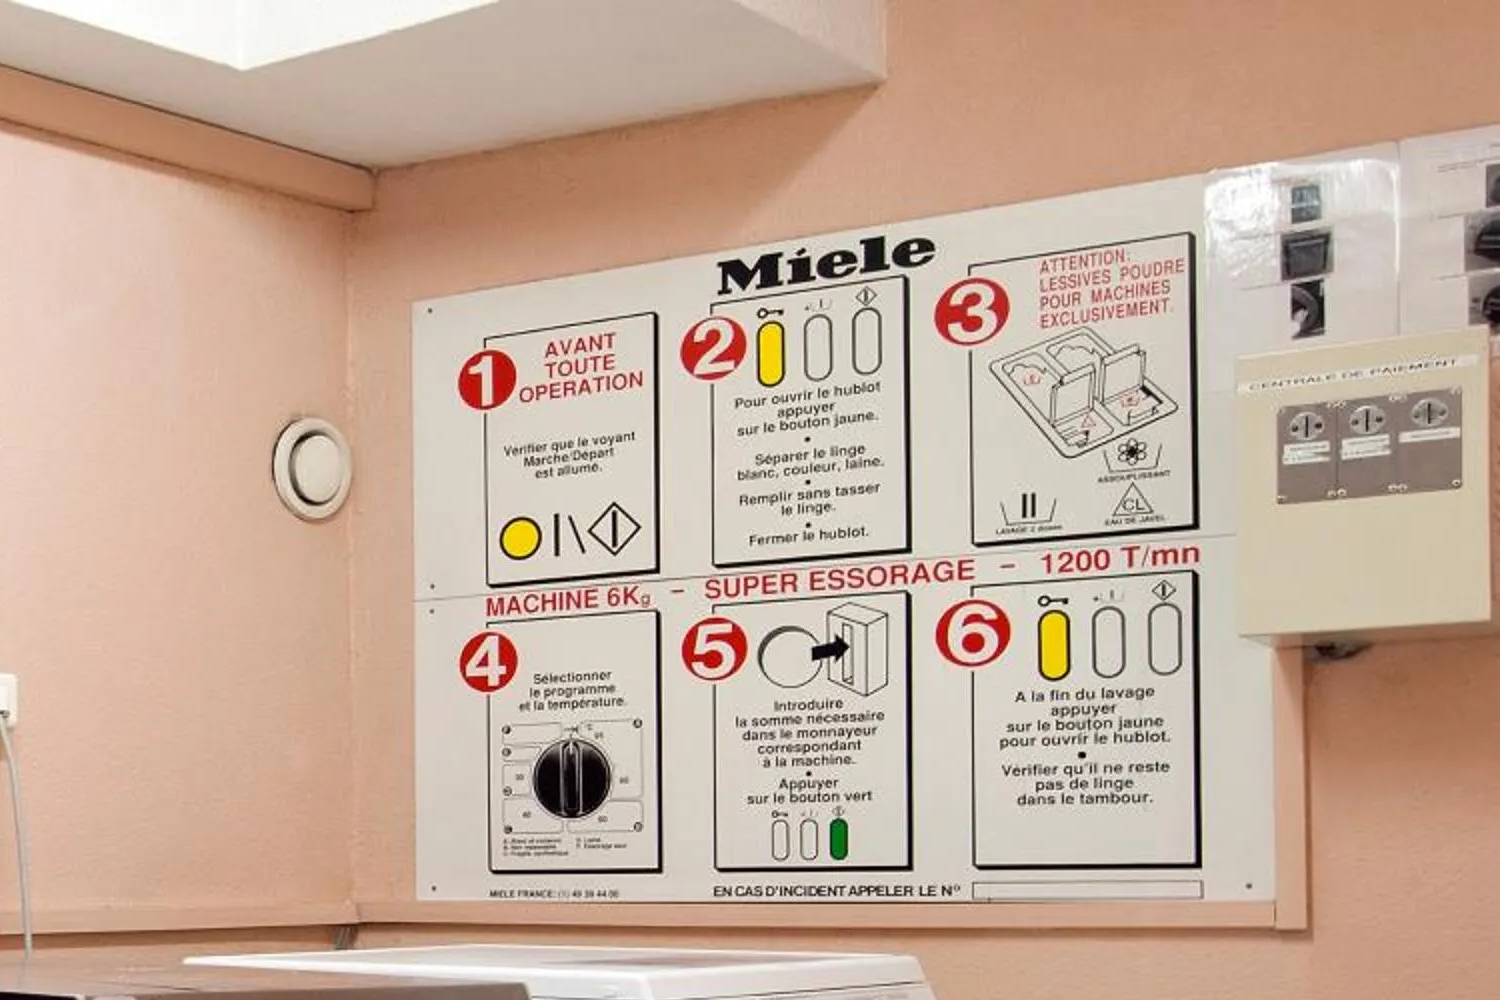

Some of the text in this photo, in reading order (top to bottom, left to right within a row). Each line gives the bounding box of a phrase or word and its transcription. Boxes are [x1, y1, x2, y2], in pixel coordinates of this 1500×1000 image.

[717, 236, 936, 295] Miele
[1040, 258, 1185, 293] LESSIVES POUDRE
[1040, 279, 1172, 311] POUR MACHINES
[948, 282, 997, 343] 3
[545, 332, 616, 358] AVANT
[693, 319, 737, 375] 2
[545, 354, 616, 378] TOUTE
[1249, 359, 1457, 391] CENTRALE DE PAIEMENT
[468, 355, 494, 407] 1
[519, 371, 644, 403] OPERATION
[735, 381, 881, 410] Pour ouvrir le hublot
[777, 402, 836, 419] appuyer
[737, 411, 879, 437] sur le bouton jaune.
[551, 440, 575, 454] que
[578, 437, 589, 448] le
[592, 432, 636, 448] voyant
[755, 444, 866, 467] Séparer le linge
[535, 467, 554, 479] est
[737, 456, 885, 481] blanc, couleur, laine.
[739, 483, 881, 507] Remplir sans tasser
[781, 501, 836, 516] le linge.
[1104, 518, 1123, 527] EAU
[749, 526, 869, 546] Fermer le hublot.
[486, 588, 599, 617] MACHINE
[705, 573, 798, 599] SUPER
[809, 559, 975, 592] ESSORAGE
[1041, 550, 1110, 575] 1200
[1120, 545, 1200, 569] T/mn
[948, 602, 999, 664] 6
[466, 636, 507, 686] 4
[693, 624, 736, 679] 5
[529, 684, 617, 699] le programme
[1014, 687, 1155, 702] A la fin du lavage
[519, 701, 531, 712] et
[533, 701, 545, 711] la
[774, 699, 844, 712] Introduire
[1051, 703, 1117, 718] appuyer
[735, 709, 885, 728] la somme nécessaire
[1006, 716, 1164, 733] sur le bouton jaune
[742, 725, 877, 741] dans le monnayeur
[999, 730, 1171, 750] pour ouvrir le hublot.
[757, 739, 861, 755] correspondant
[775, 756, 787, 767] la
[1063, 762, 1098, 778] qu'il
[1103, 763, 1123, 774] ne
[1128, 761, 1171, 773] reste
[779, 778, 840, 792] Appuyer
[1035, 777, 1134, 793] pas de linge
[747, 789, 873, 805] sur le bouton vert
[1017, 792, 1154, 805] dans le tambour.
[489, 889, 515, 898] MIELE
[713, 886, 732, 897] EN
[734, 886, 763, 897] CAS
[765, 885, 846, 897] D'INCIDENT
[847, 885, 914, 897] APPELER
[919, 885, 937, 896] LE
